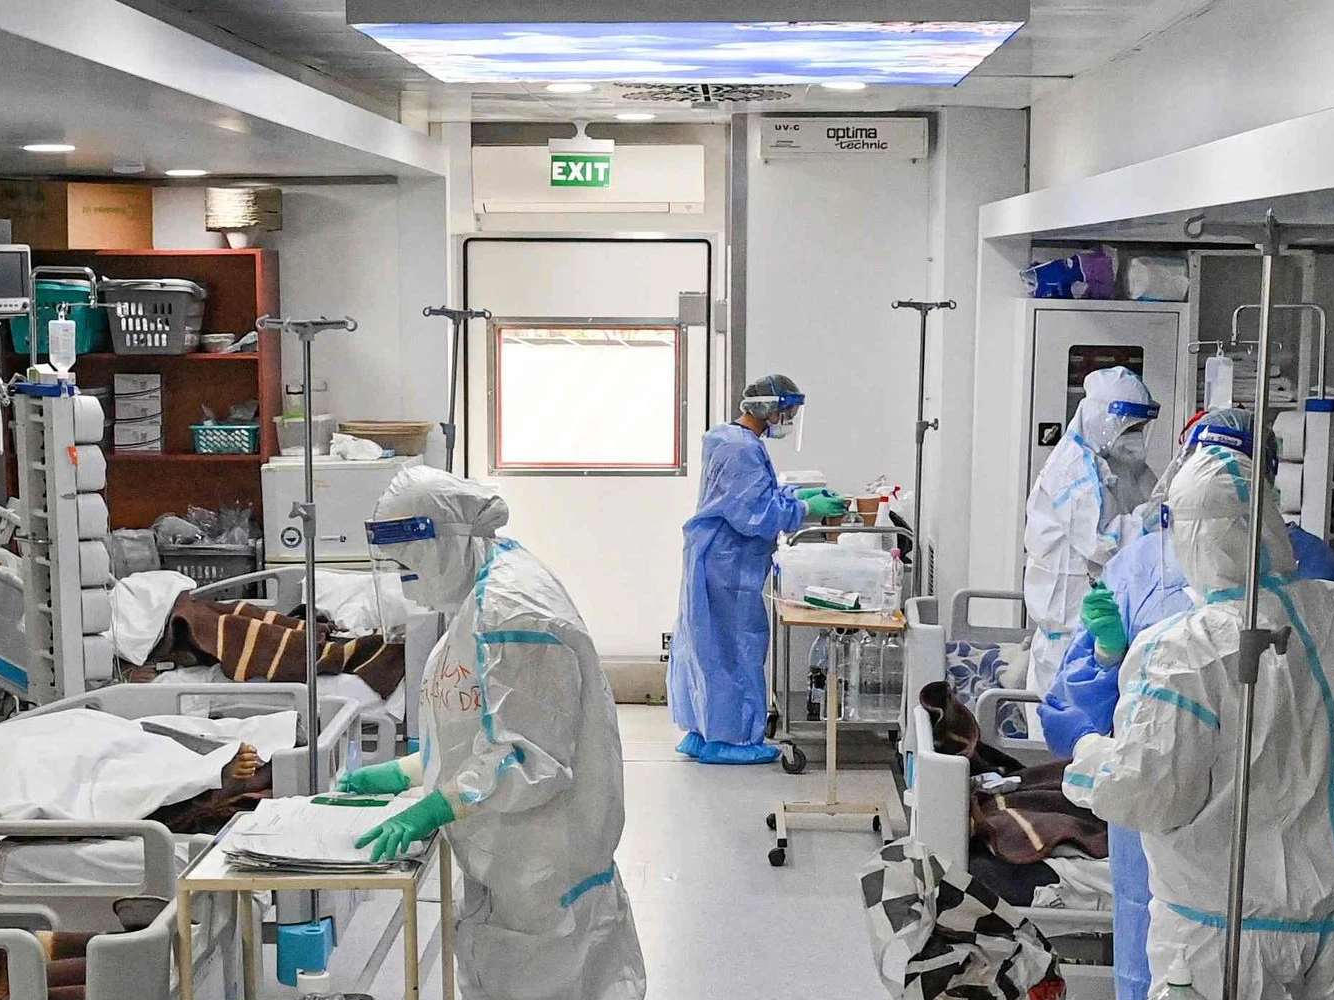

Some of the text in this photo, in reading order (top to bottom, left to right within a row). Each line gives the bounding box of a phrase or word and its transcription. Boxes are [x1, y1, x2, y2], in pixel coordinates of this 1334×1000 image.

[826, 127, 878, 141] optima
[835, 139, 889, 150] technic
[552, 161, 609, 182] EXIT
